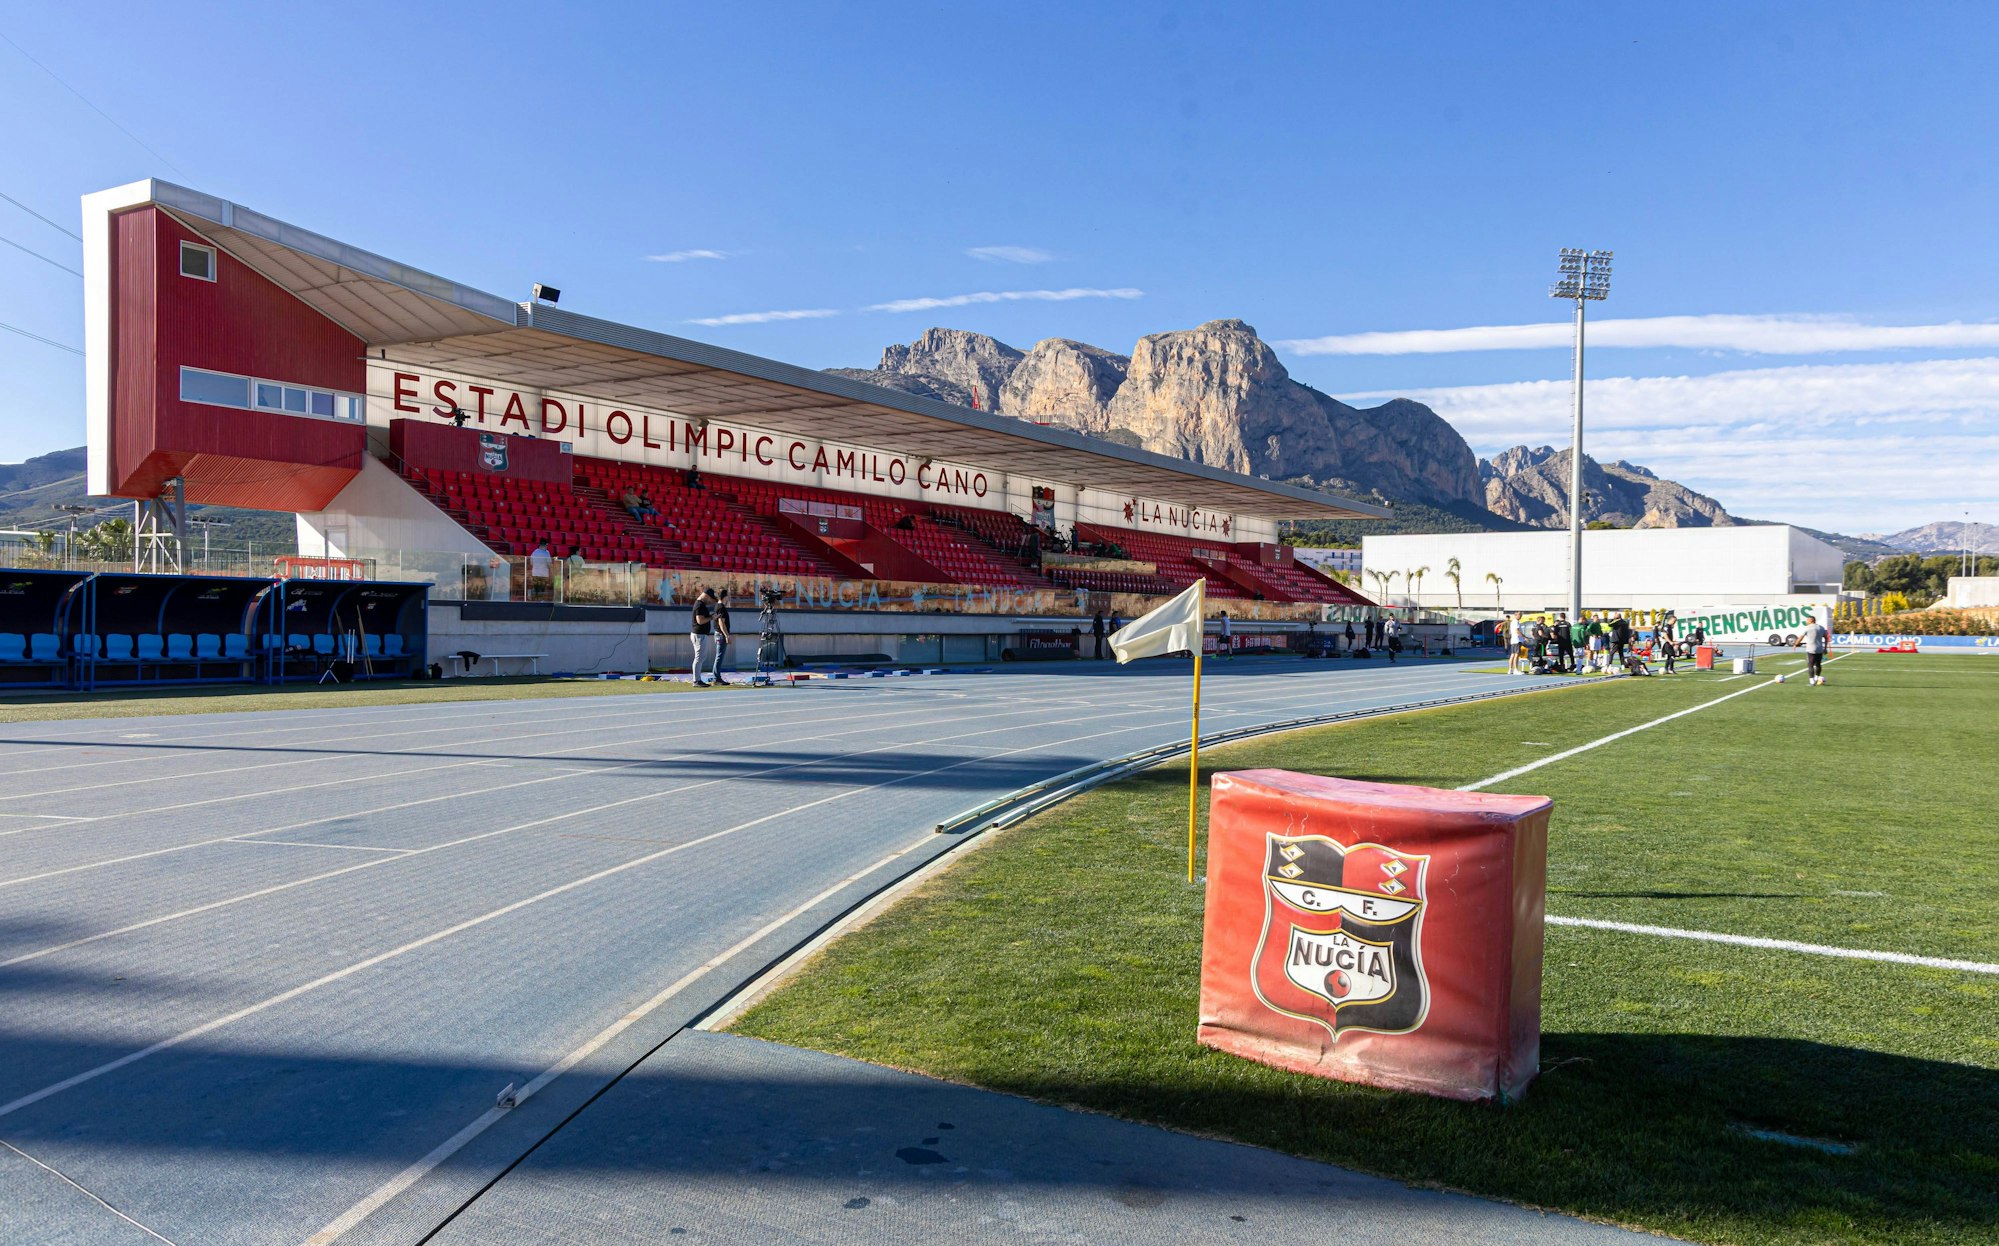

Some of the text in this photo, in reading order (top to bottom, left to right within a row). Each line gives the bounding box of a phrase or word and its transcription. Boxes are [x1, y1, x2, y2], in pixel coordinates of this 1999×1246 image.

[395, 372, 988, 498] ESTADI OLIMPIC CAMILO CANO
[1142, 502, 1218, 532] LA NUCIA
[1837, 634, 1883, 646] CAMILO
[1333, 935, 1350, 948] LA
[1292, 936, 1390, 984] NUCÍA
